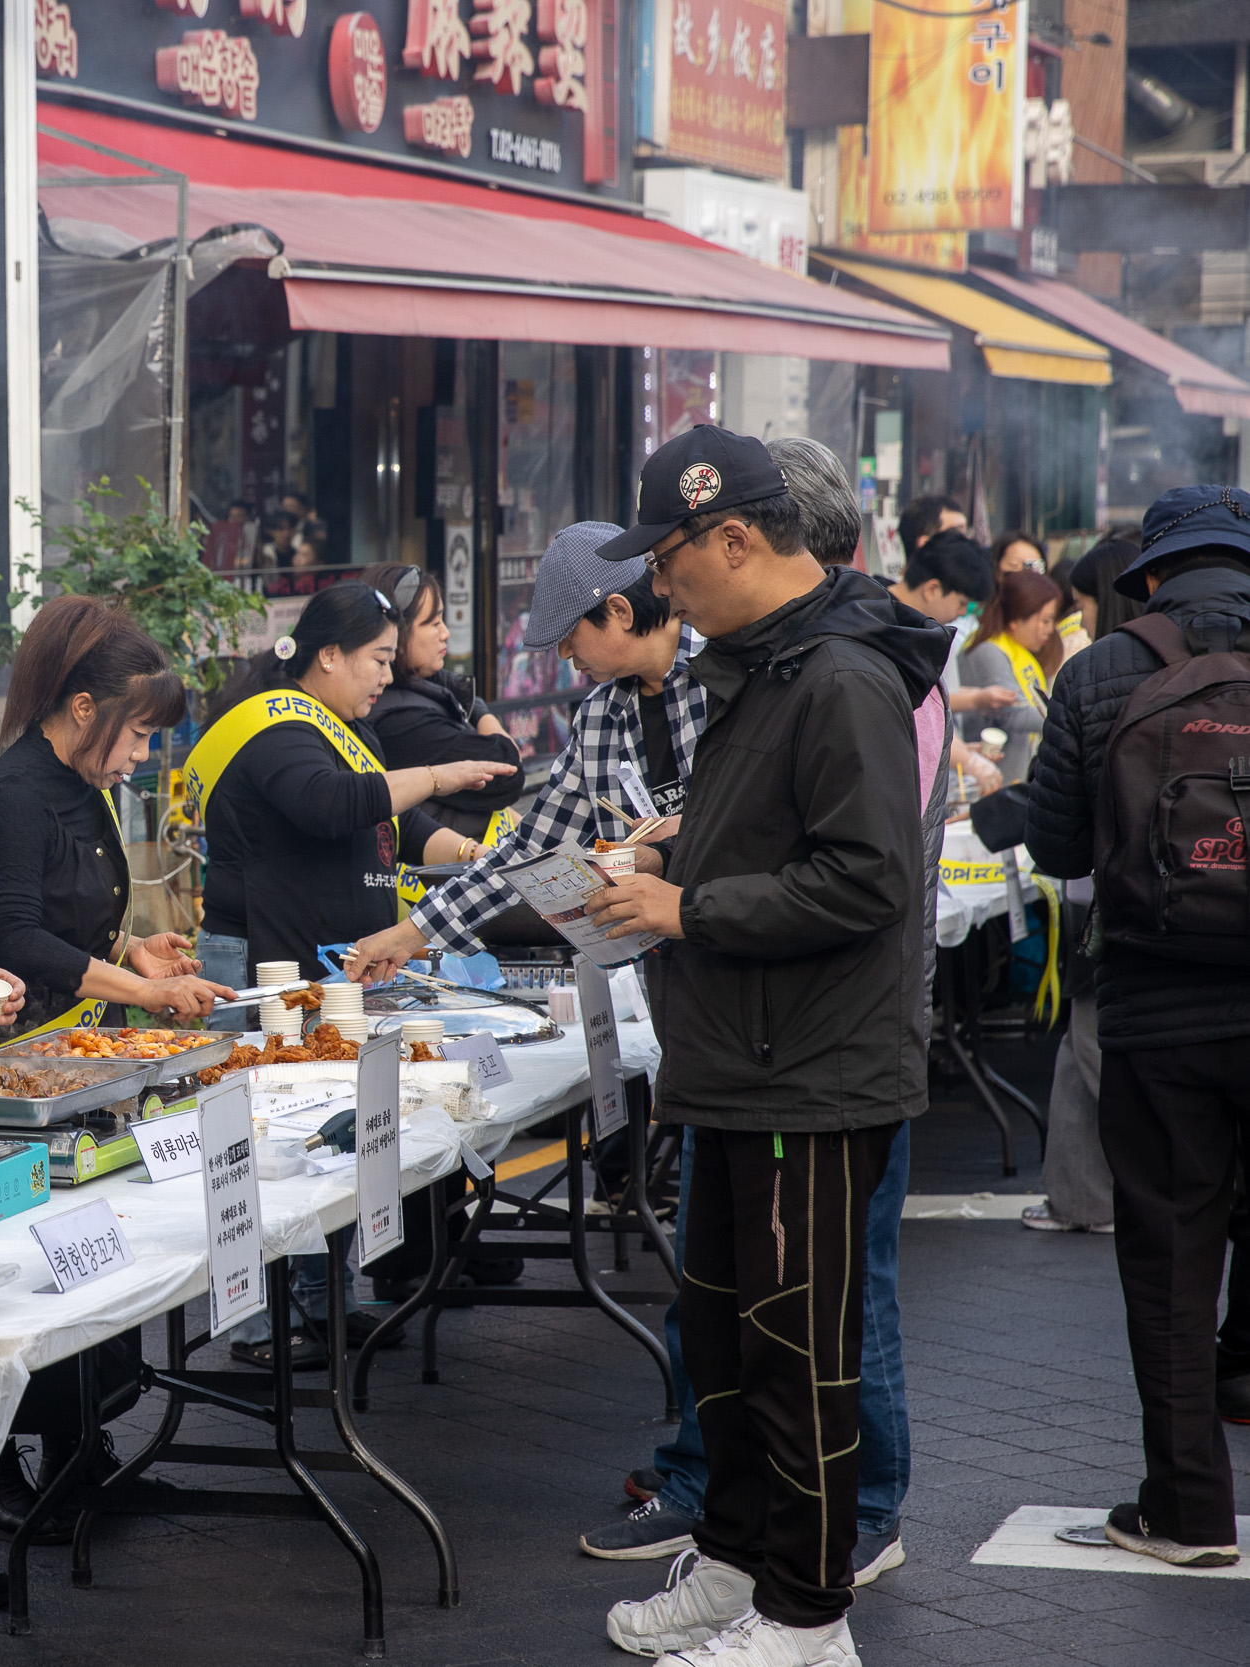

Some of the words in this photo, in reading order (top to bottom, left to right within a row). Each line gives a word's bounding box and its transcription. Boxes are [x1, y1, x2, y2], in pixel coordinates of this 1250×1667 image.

[613, 858, 632, 868] Classic
[365, 1114, 382, 1135] 차례대로
[366, 1136, 380, 1158] 주시길
[380, 1128, 396, 1150] 바랍니다
[214, 1152, 223, 1170] 사람
[211, 1172, 229, 1194] 무료시식
[229, 1161, 250, 1185] 가능합니다
[220, 1204, 238, 1225] 차례대로
[238, 1199, 247, 1216] 줄을
[222, 1225, 236, 1247] 주시길
[236, 1217, 253, 1239] 바랍니다
